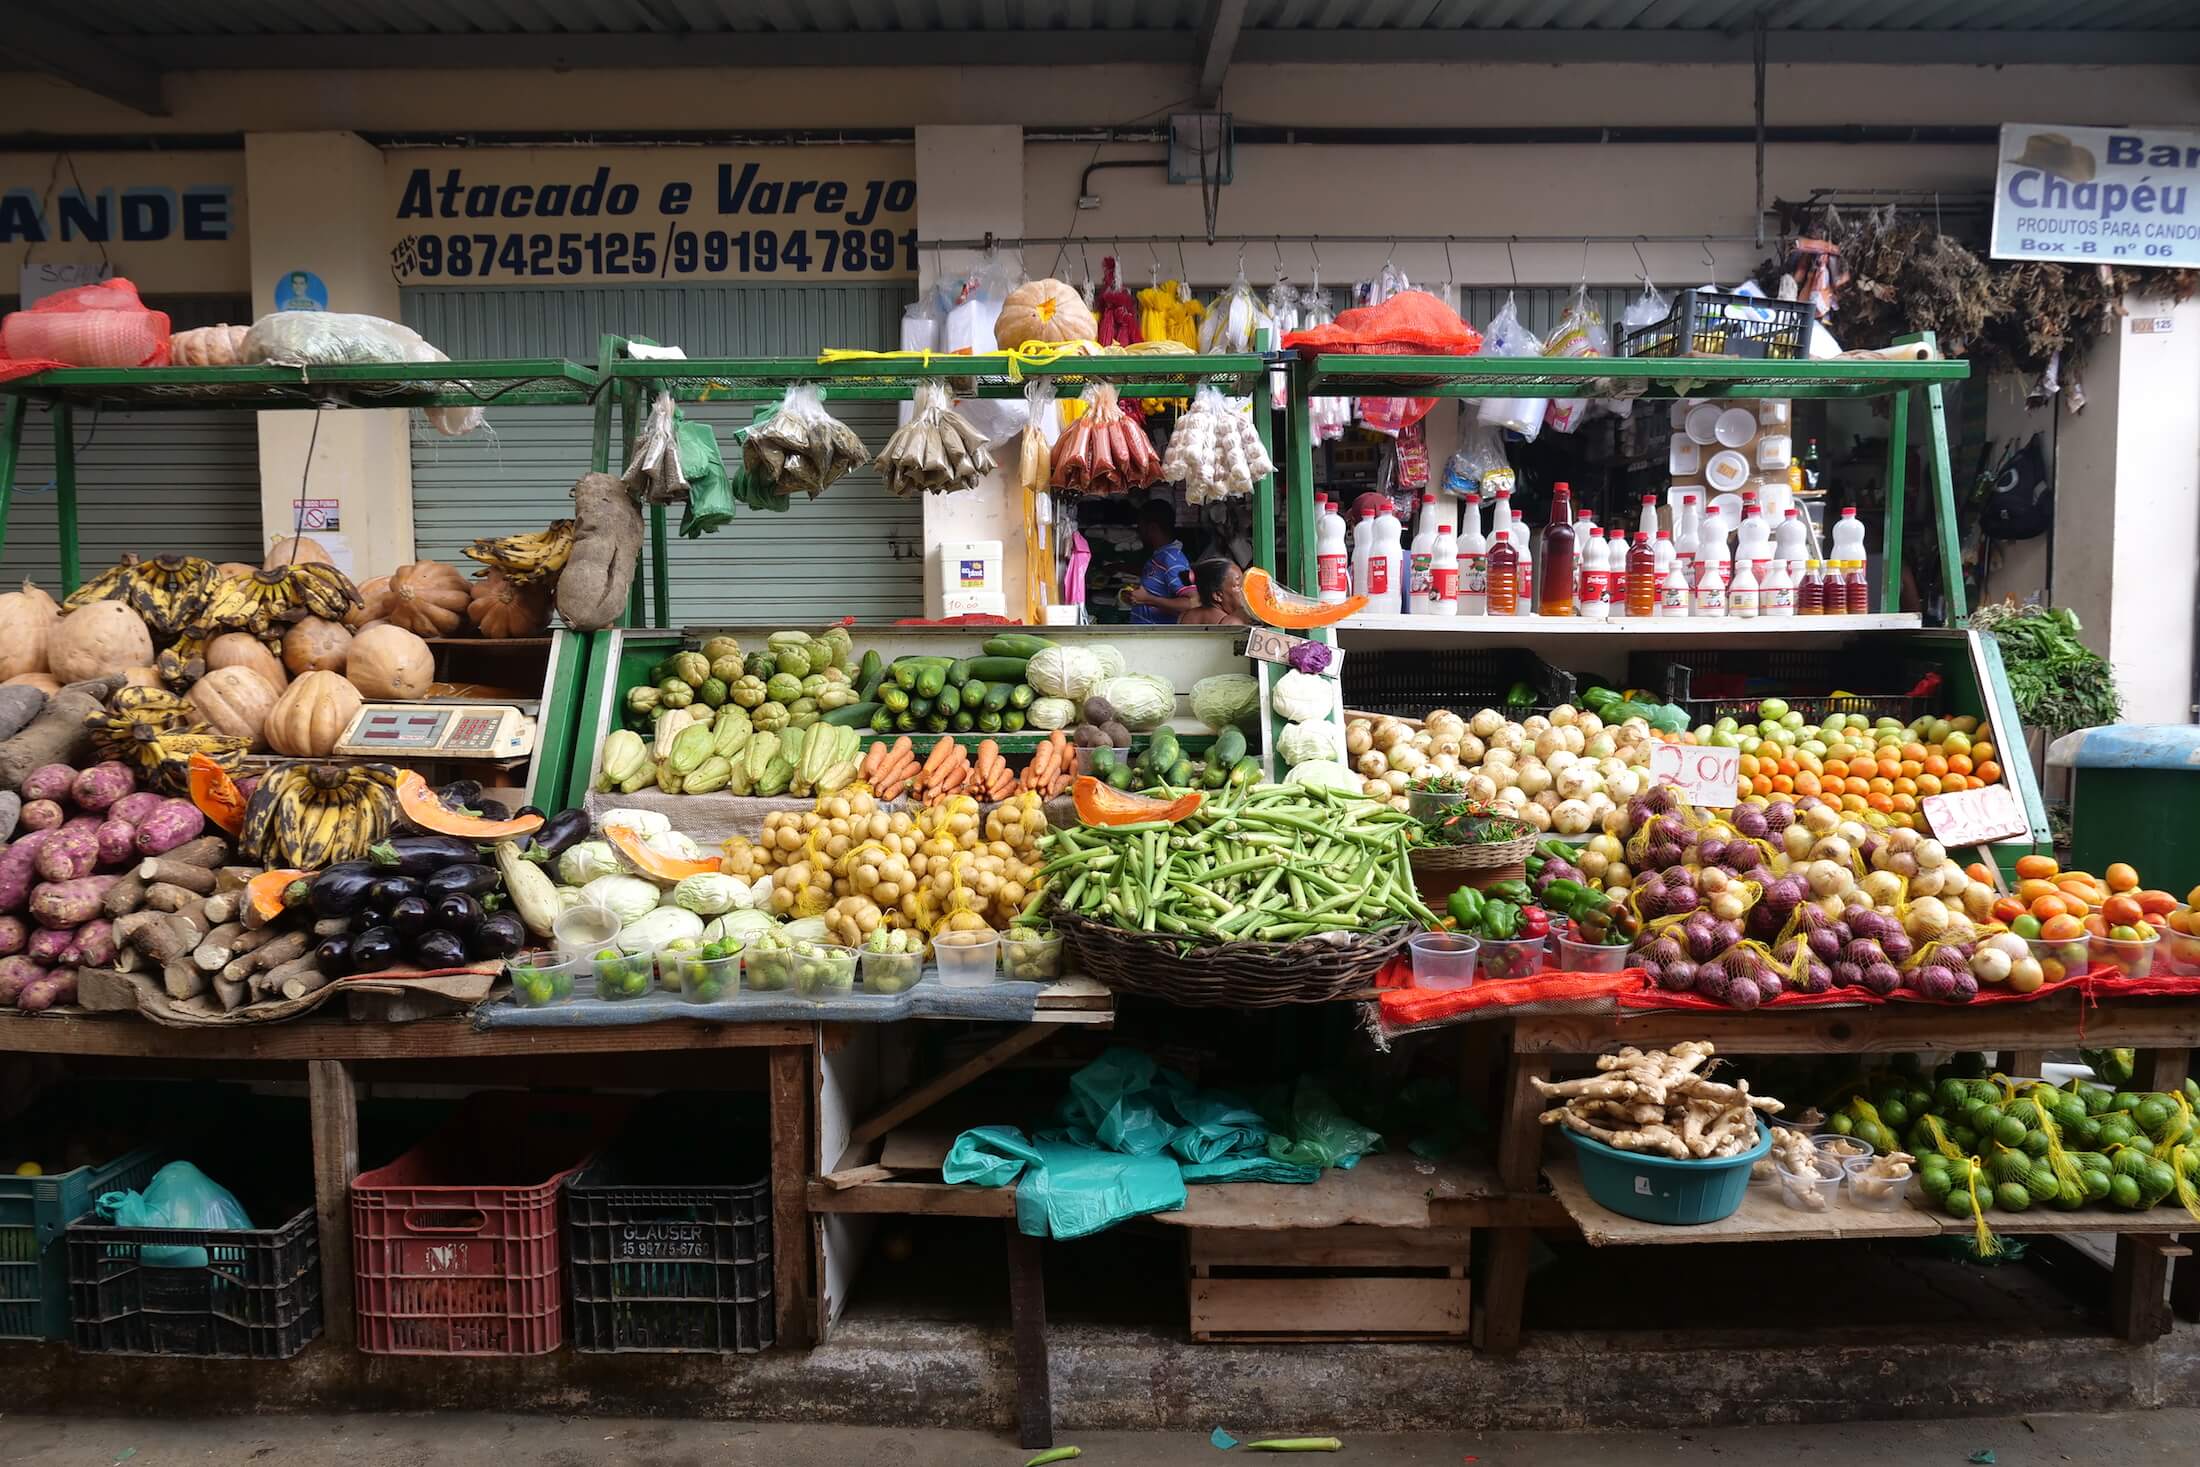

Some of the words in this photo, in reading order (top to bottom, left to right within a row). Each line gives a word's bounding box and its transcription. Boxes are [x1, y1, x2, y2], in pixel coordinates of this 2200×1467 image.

[397, 167, 639, 218] Atacado
[659, 183, 692, 215] e
[717, 163, 917, 226] Varejo
[2008, 169, 2187, 219] Chapéu
[2016, 217, 2098, 236] PRODUTOS
[2102, 221, 2141, 238] PARA
[2145, 223, 2200, 241] CANDO
[2020, 238, 2065, 252] Box
[2144, 244, 2173, 257] 06
[623, 1224, 702, 1241] GLAUSER
[622, 1242, 635, 1255] 15
